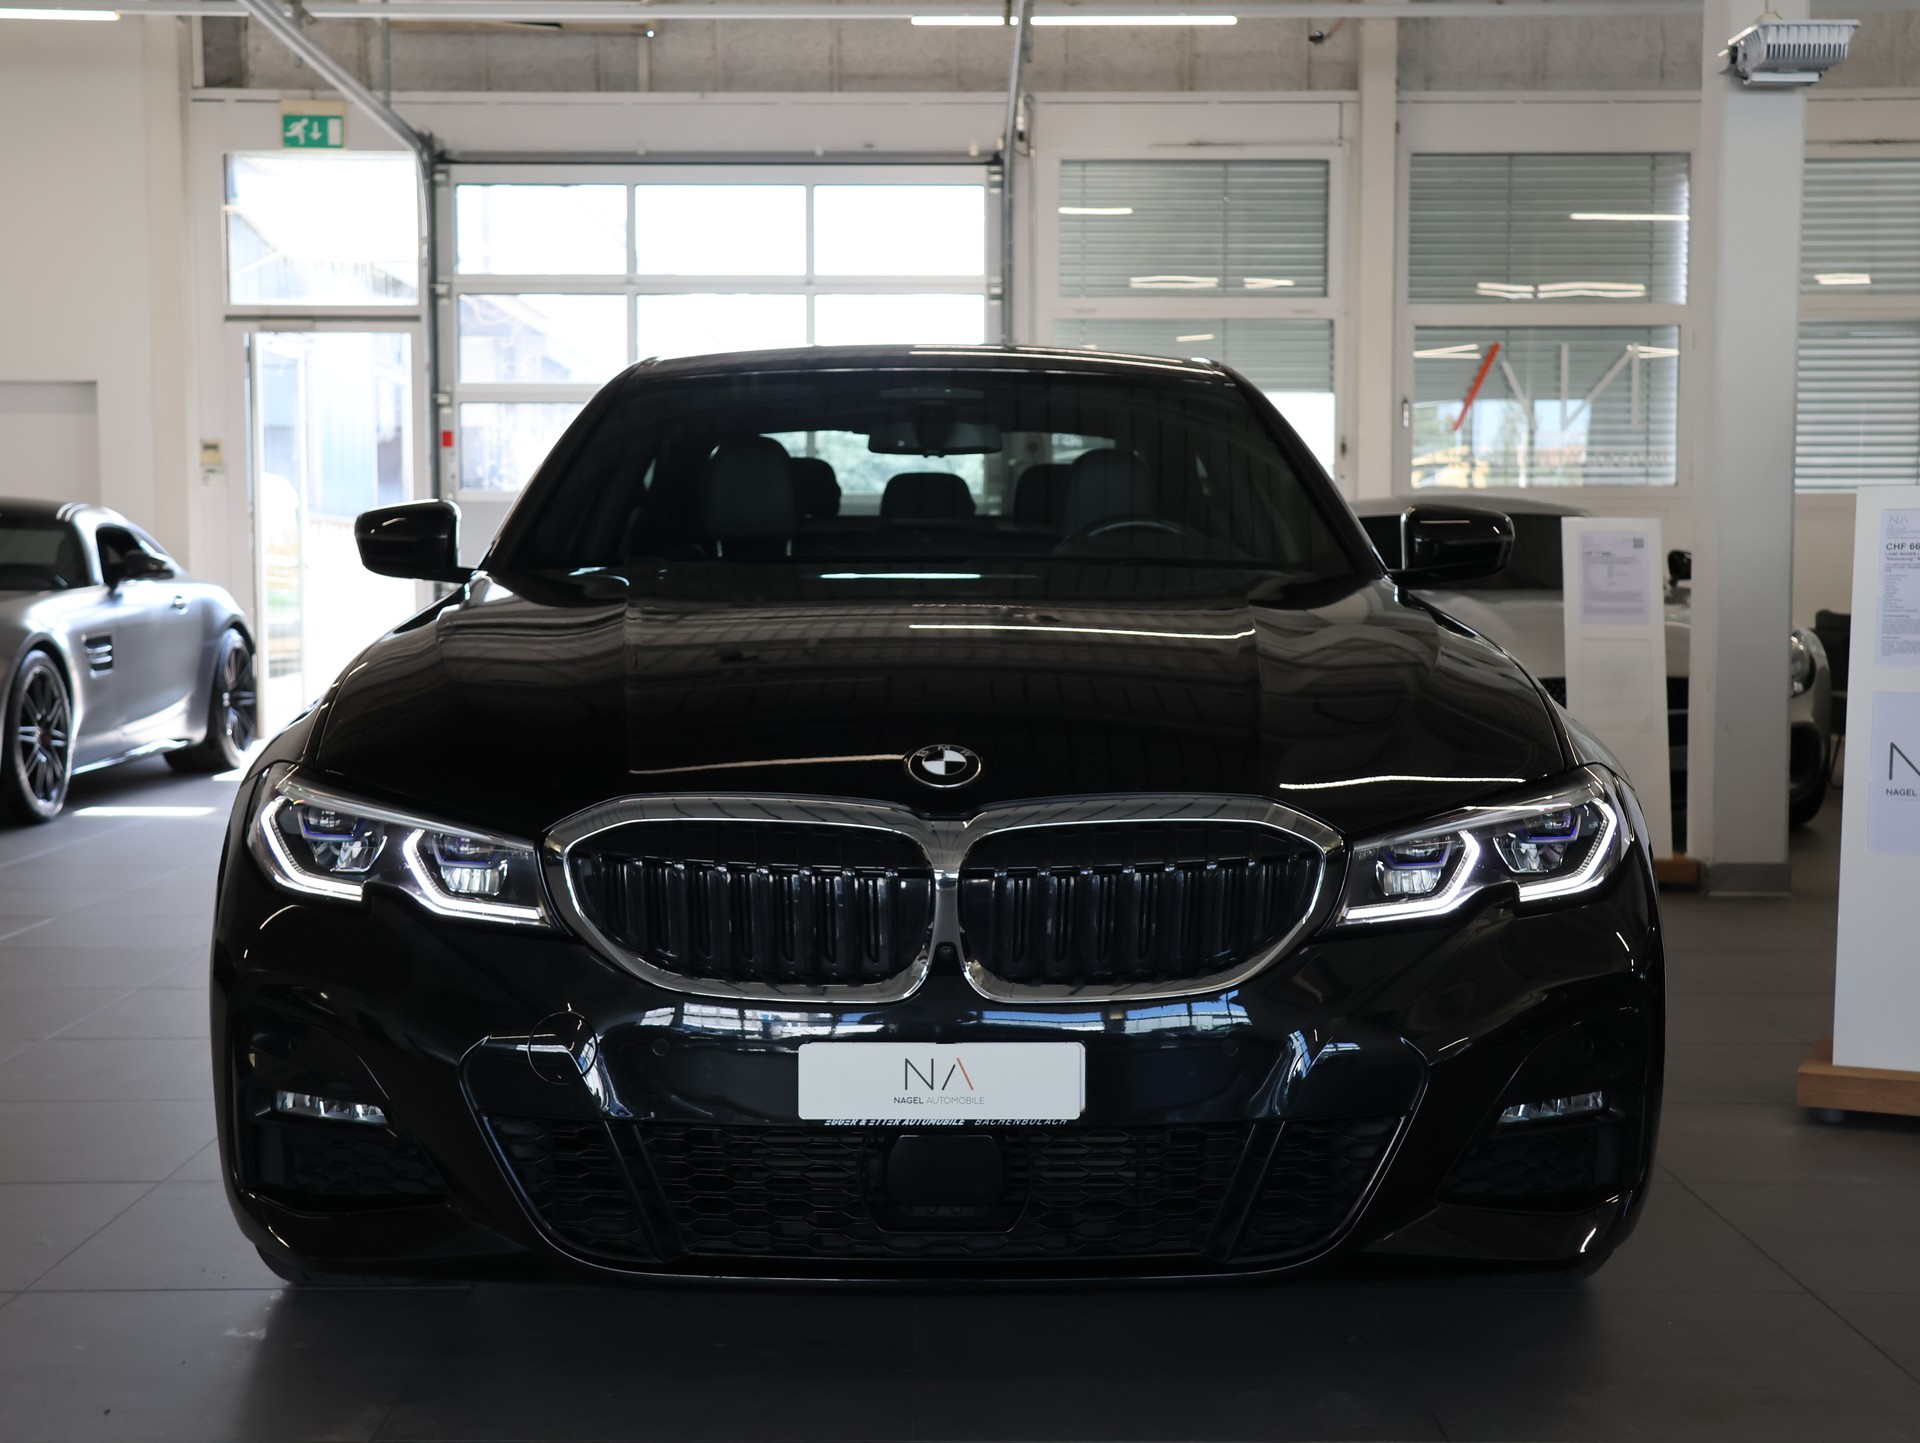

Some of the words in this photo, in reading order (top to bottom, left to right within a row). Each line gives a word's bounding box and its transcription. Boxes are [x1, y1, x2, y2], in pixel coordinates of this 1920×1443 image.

[915, 745, 974, 757] BMW
[1885, 788, 1917, 796] NAGEL
[904, 1057, 974, 1091] NA
[893, 1096, 924, 1105] NAGEL
[926, 1096, 985, 1105] AUTOMOBILE
